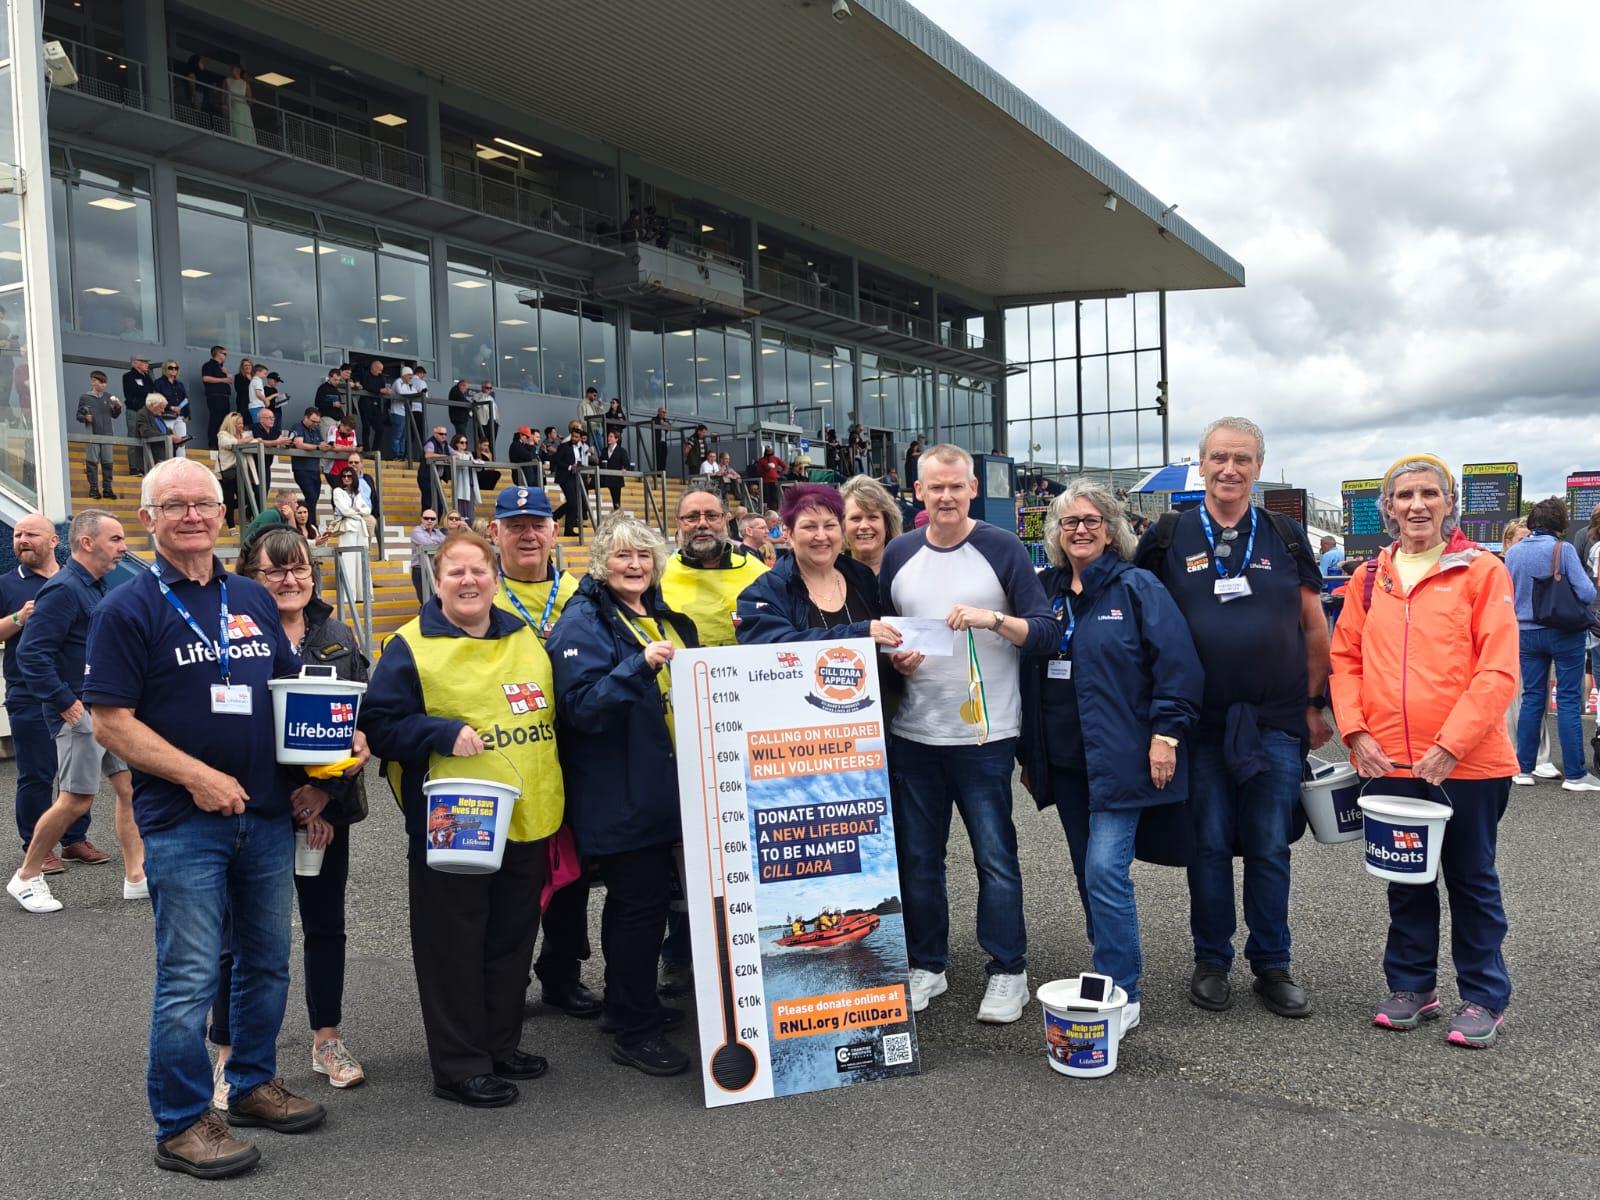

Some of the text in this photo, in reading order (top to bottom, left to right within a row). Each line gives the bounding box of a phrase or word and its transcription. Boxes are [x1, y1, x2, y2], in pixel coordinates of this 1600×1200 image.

[1187, 563, 1209, 573] CREW
[710, 667, 738, 679] €117k
[748, 668, 804, 682] Lifeboats
[820, 668, 861, 677] CILL DARA
[824, 677, 856, 686] APPEAL
[712, 692, 740, 704] €110k
[288, 721, 353, 739] Lifeboats
[714, 721, 743, 733] €100k
[480, 720, 553, 750] eboats
[750, 723, 878, 745] CALLING ON KILDARE!
[717, 752, 740, 762] €90k
[752, 741, 853, 761] WILL YOU HELP
[754, 754, 881, 777] RNLI VOLUNTEERS?
[719, 782, 743, 793] €80k
[458, 797, 494, 808] Help save
[451, 805, 470, 815] lives
[758, 800, 885, 825] DONATE TOWARDS
[722, 812, 745, 823] €70k
[759, 819, 879, 844] A NEW LIFEBOAT,
[724, 842, 748, 853] €60k
[761, 839, 856, 862] TO BE NAMED
[1365, 840, 1424, 863] Lifeboats
[762, 859, 832, 879] CILL DARA
[727, 873, 750, 884] €50k
[729, 903, 753, 915] €40k
[732, 934, 756, 945] €30k
[735, 966, 758, 977] €20k
[738, 997, 762, 1008] €10k
[777, 991, 899, 1017] Please donate online at
[740, 1027, 759, 1040] €0k
